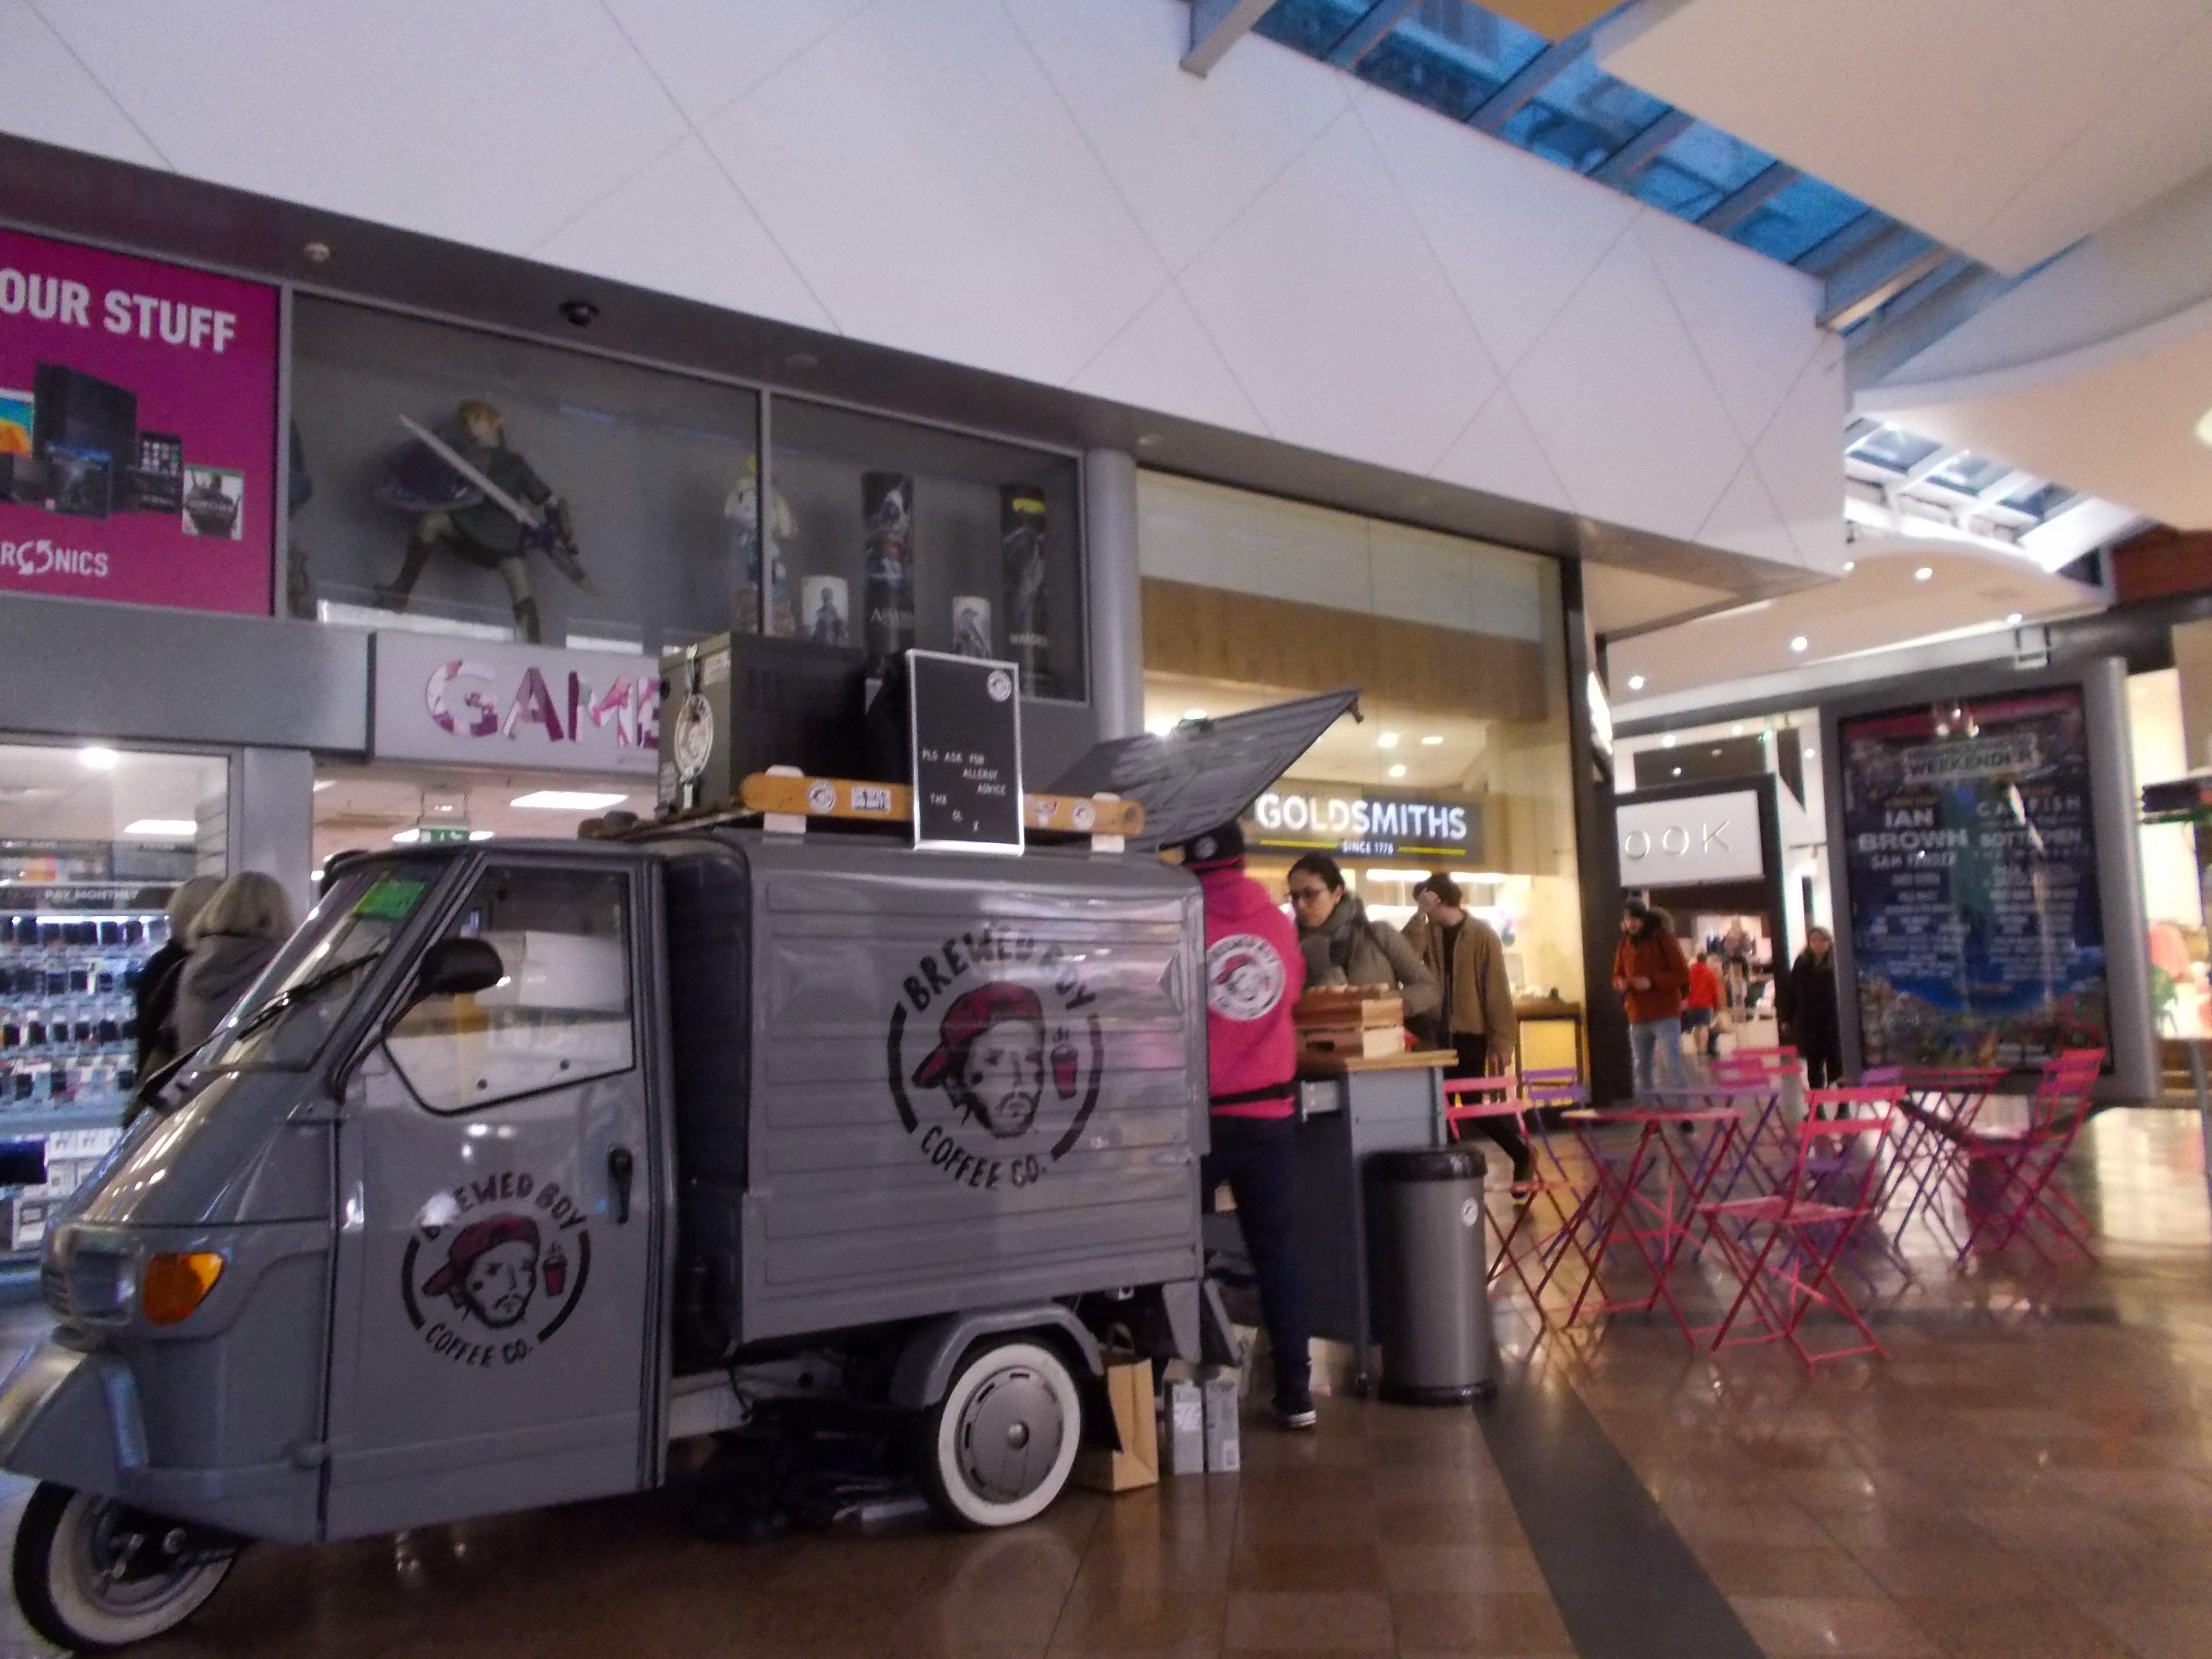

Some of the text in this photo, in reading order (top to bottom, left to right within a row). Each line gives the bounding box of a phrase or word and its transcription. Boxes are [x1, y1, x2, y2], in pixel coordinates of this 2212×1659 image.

[102, 289, 237, 354] STUFF
[1255, 793, 1467, 840] GOLDSMITHS
[1885, 808, 1934, 828] IAN
[1343, 840, 1371, 855] SINCE
[1859, 829, 1969, 852] BROWN
[920, 1125, 1002, 1189] COFFEE
[535, 1182, 588, 1231] BOY
[425, 1323, 494, 1368] COFFEE
